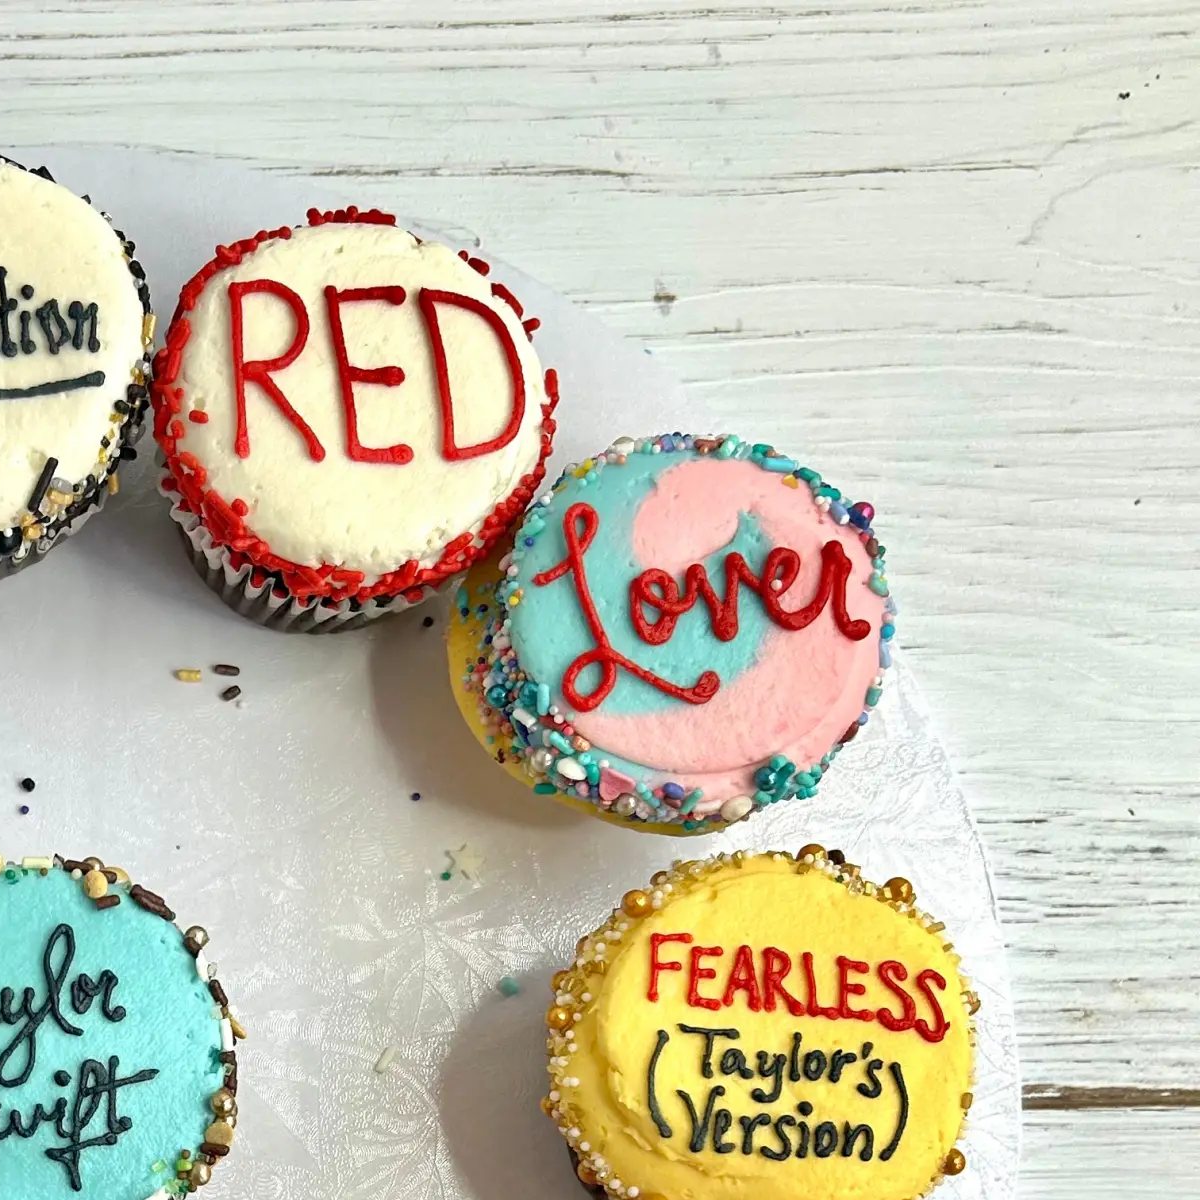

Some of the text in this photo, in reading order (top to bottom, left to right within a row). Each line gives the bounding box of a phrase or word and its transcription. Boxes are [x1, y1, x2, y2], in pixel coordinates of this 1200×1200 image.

[227, 283, 528, 467] RED
[532, 502, 871, 714] Lover
[646, 931, 951, 1044] FEARLESS
